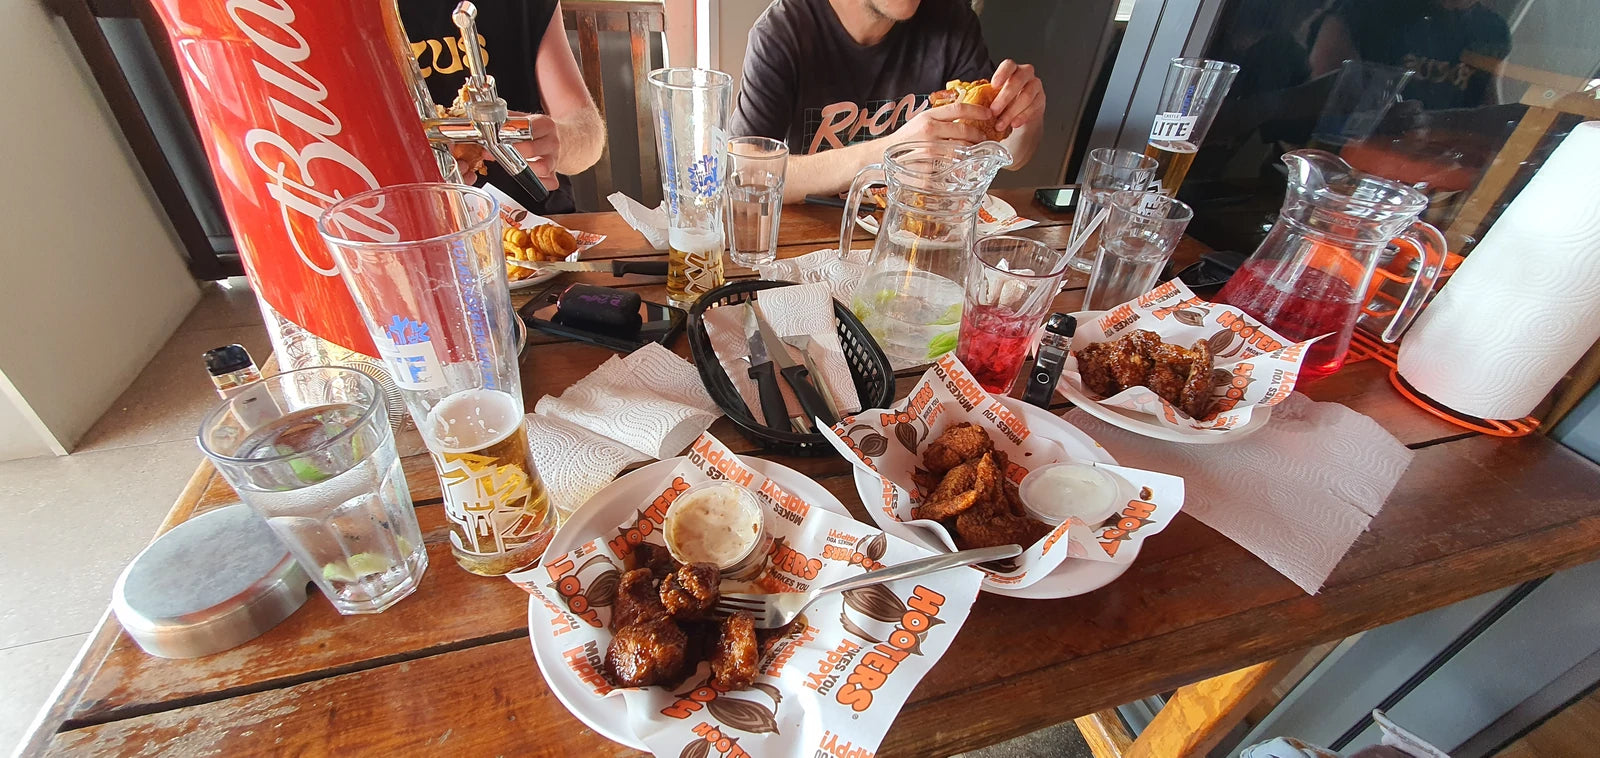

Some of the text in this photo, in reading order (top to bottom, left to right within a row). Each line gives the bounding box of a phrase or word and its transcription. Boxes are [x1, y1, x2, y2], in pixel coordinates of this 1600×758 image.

[1152, 121, 1190, 137] LITE
[1157, 288, 1181, 303] MAKES
[1113, 313, 1141, 332] MAKES
[932, 361, 974, 413] MAKES YOU
[937, 353, 987, 407] HAPPY!
[1271, 368, 1284, 385] YOU
[880, 381, 934, 426] HOOTERS
[989, 400, 1031, 441] HAPPY!
[982, 409, 1023, 446] MAKES YOU
[687, 449, 706, 471] YOU
[691, 434, 754, 487] HAPPY!
[760, 477, 811, 517] HAPPY!
[773, 502, 804, 527] MAKES
[769, 568, 794, 587] MAKES
[795, 582, 810, 592] YOU
[767, 625, 820, 678] HAPPY!
[836, 585, 946, 712] HOOTERS
[817, 674, 841, 696] YOU
